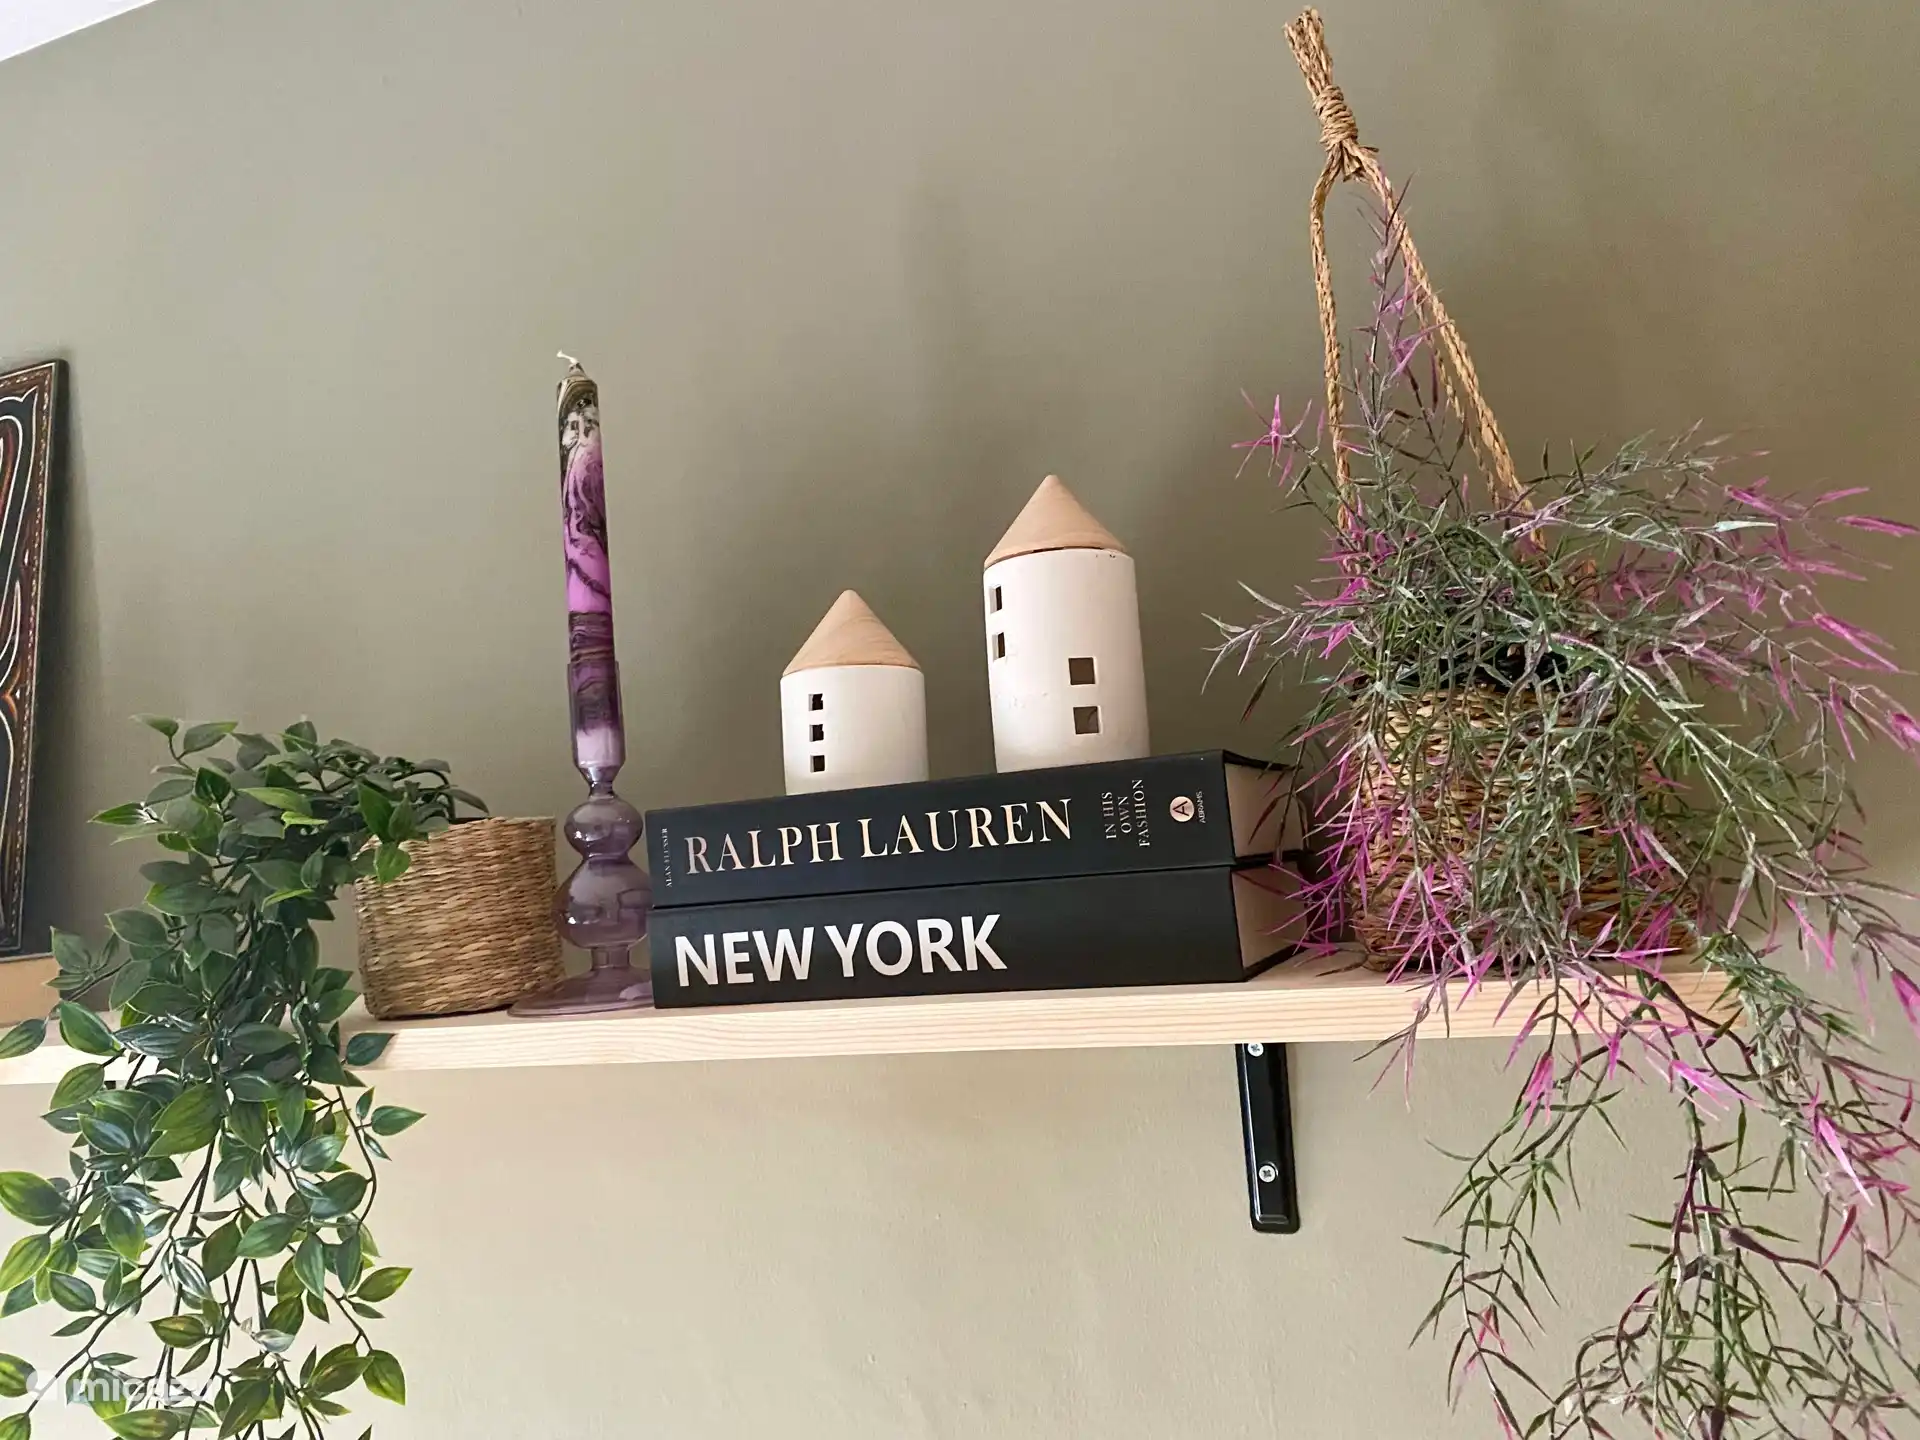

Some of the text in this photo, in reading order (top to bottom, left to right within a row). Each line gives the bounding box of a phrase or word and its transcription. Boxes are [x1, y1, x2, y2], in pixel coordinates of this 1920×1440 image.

[683, 798, 1073, 875] RALPH LAUREN
[1101, 791, 1117, 840] IN HIS
[1117, 795, 1132, 834] OWN
[1131, 779, 1151, 848] FASHION
[1195, 790, 1206, 824] ABRAMS
[674, 913, 1008, 987] NEW YORK
